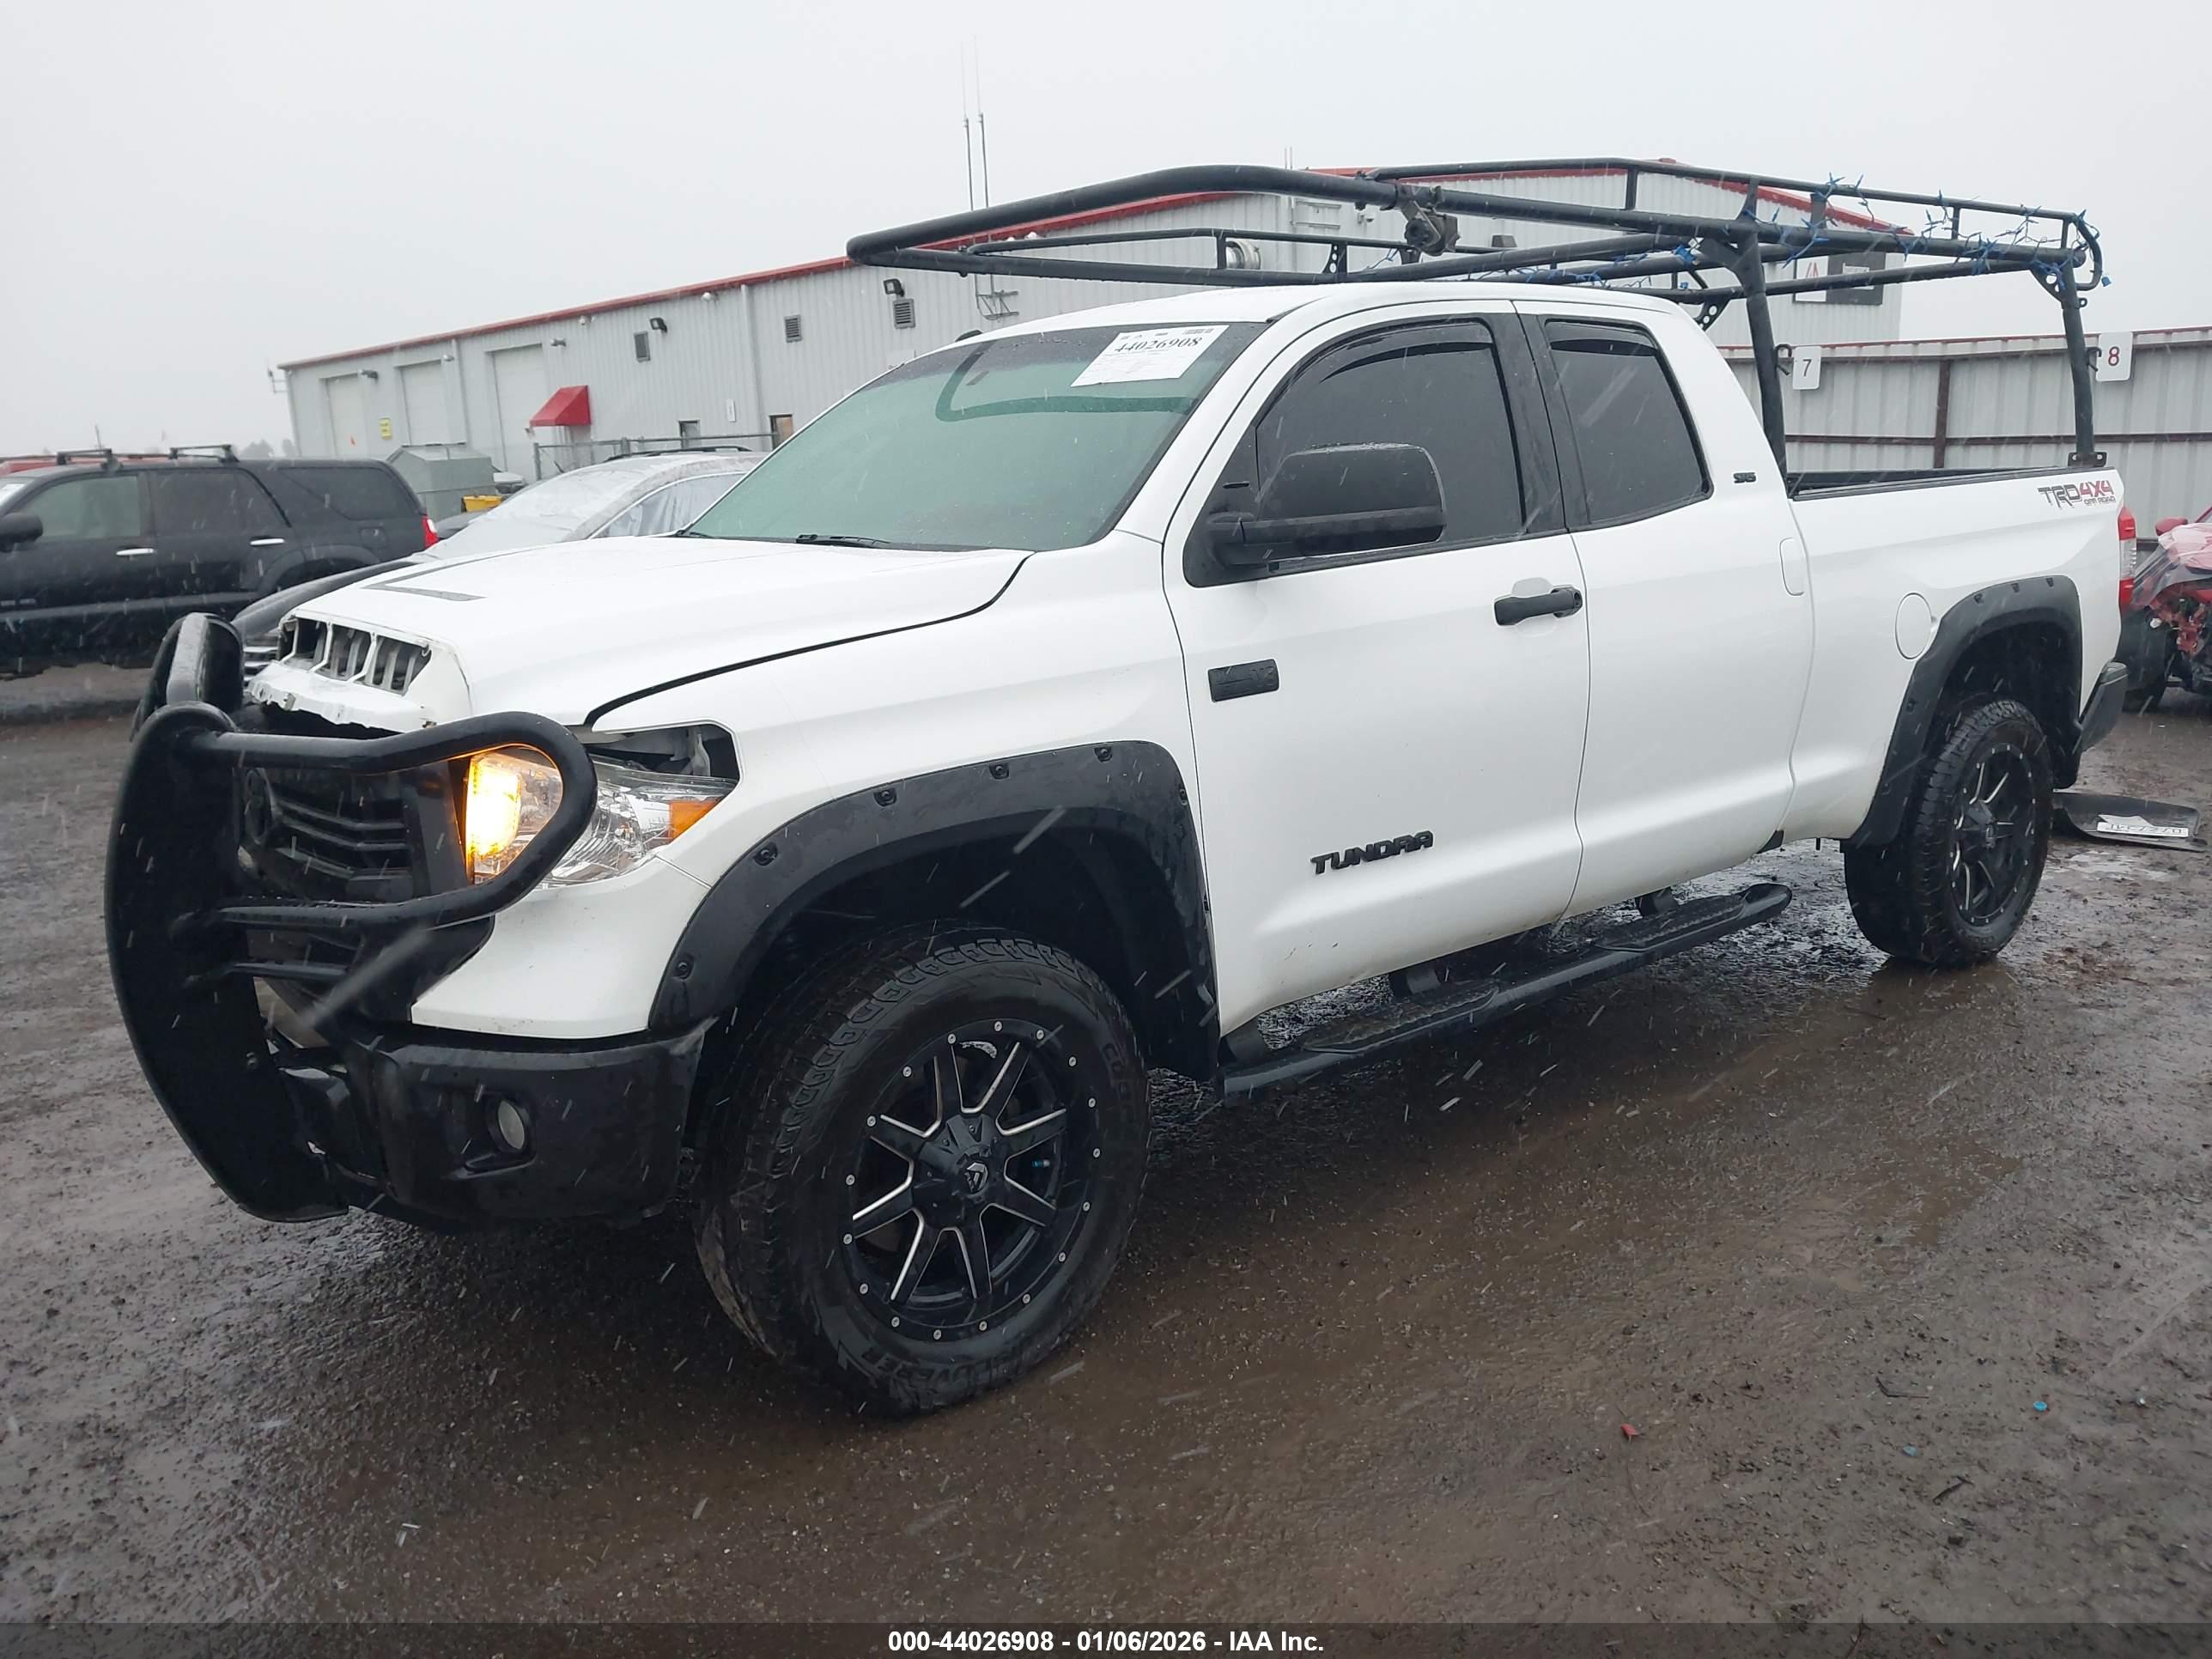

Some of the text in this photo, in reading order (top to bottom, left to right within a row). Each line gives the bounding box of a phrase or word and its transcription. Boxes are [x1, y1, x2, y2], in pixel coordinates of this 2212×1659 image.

[1115, 337, 1203, 353] 44026908
[2108, 346, 2120, 367] 8
[1802, 358, 1812, 377] 7
[2037, 483, 2081, 508] TRD
[1310, 830, 1435, 875] TUNDRA
